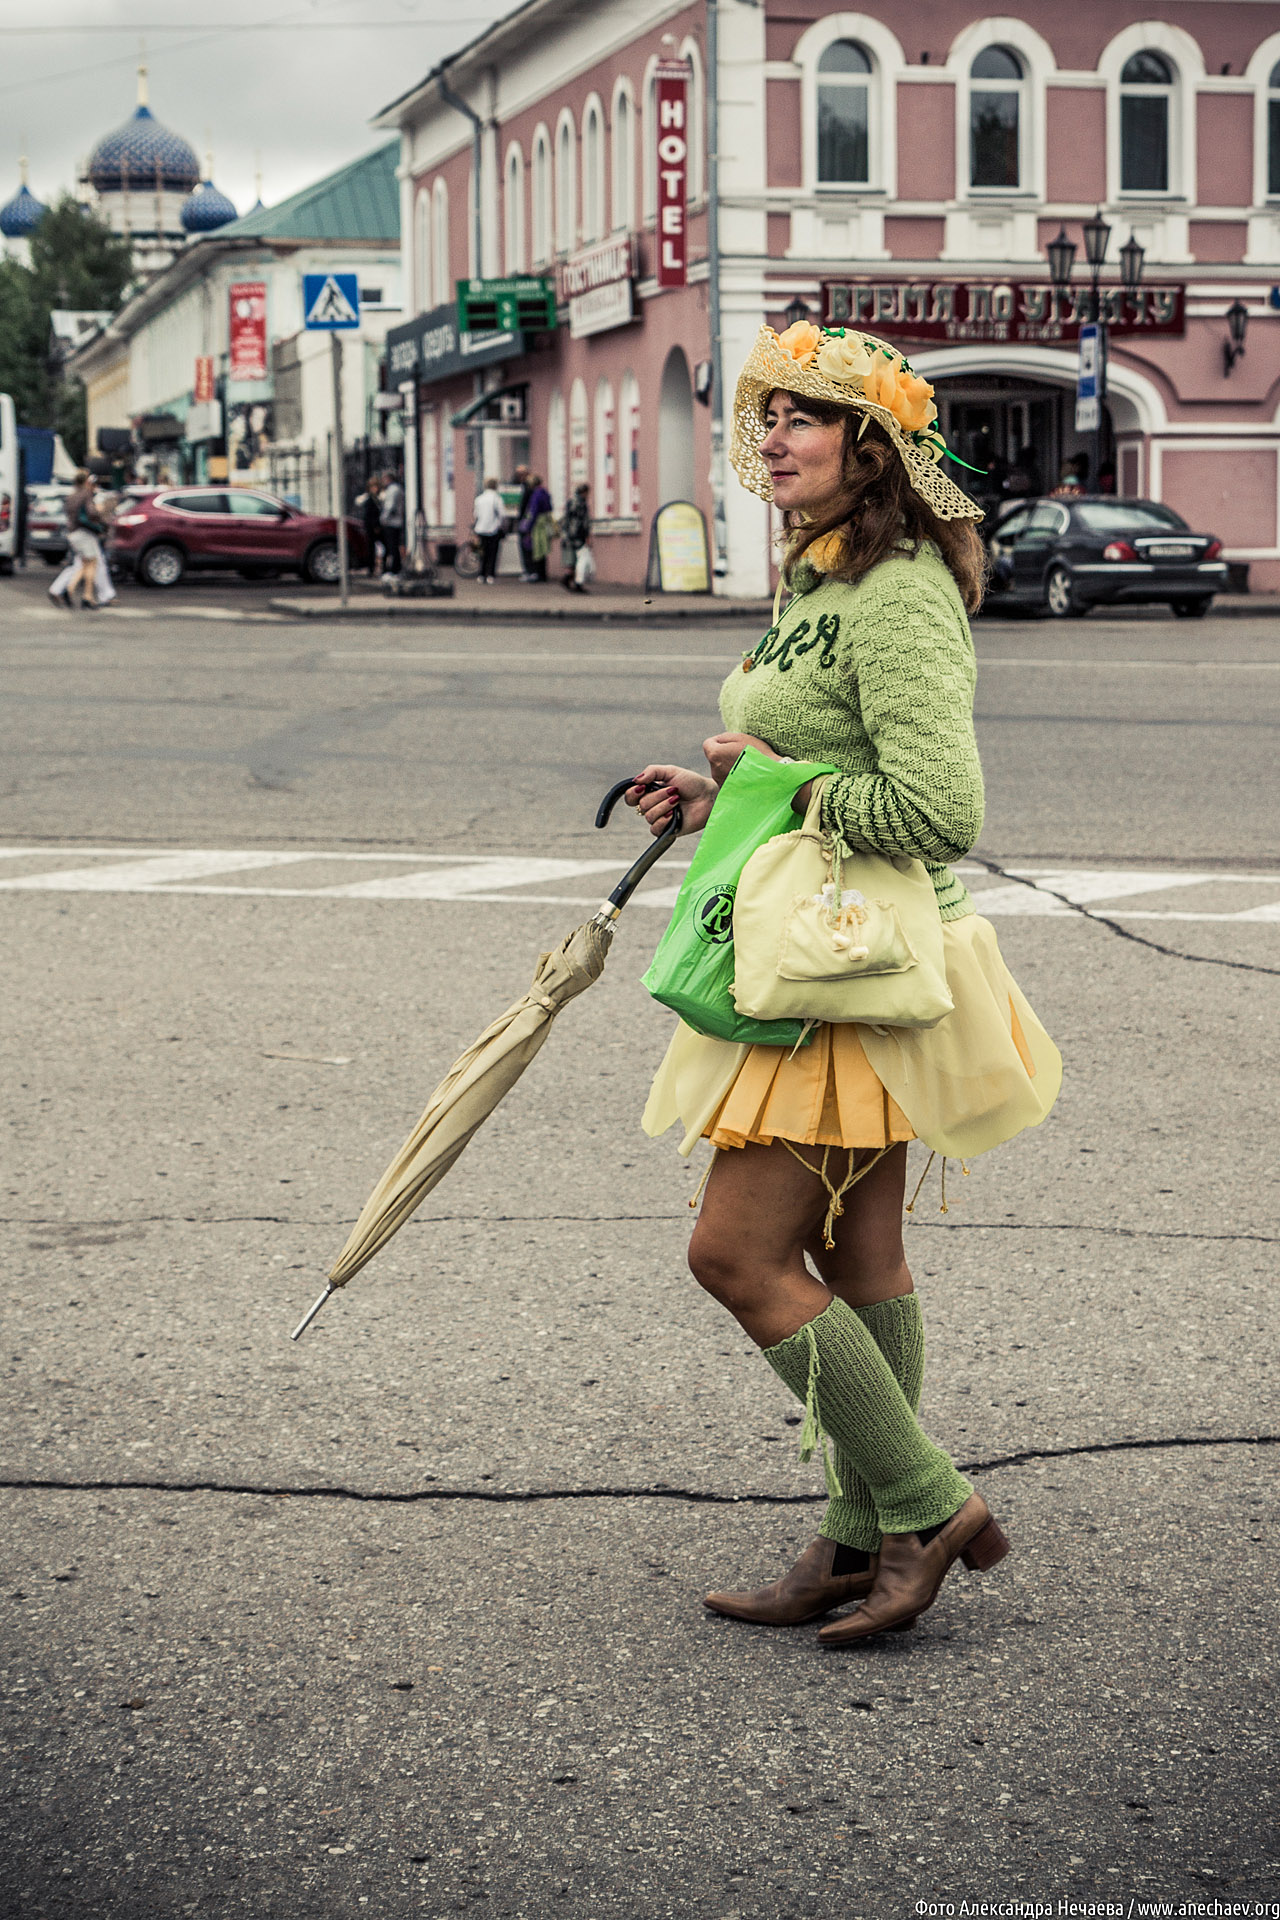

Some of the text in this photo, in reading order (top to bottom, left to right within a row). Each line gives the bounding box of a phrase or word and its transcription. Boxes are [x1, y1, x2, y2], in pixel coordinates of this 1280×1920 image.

[658, 99, 687, 269] HOTEL
[825, 284, 1181, 325] ВРЕМЯ ПО УГЛИЧУ
